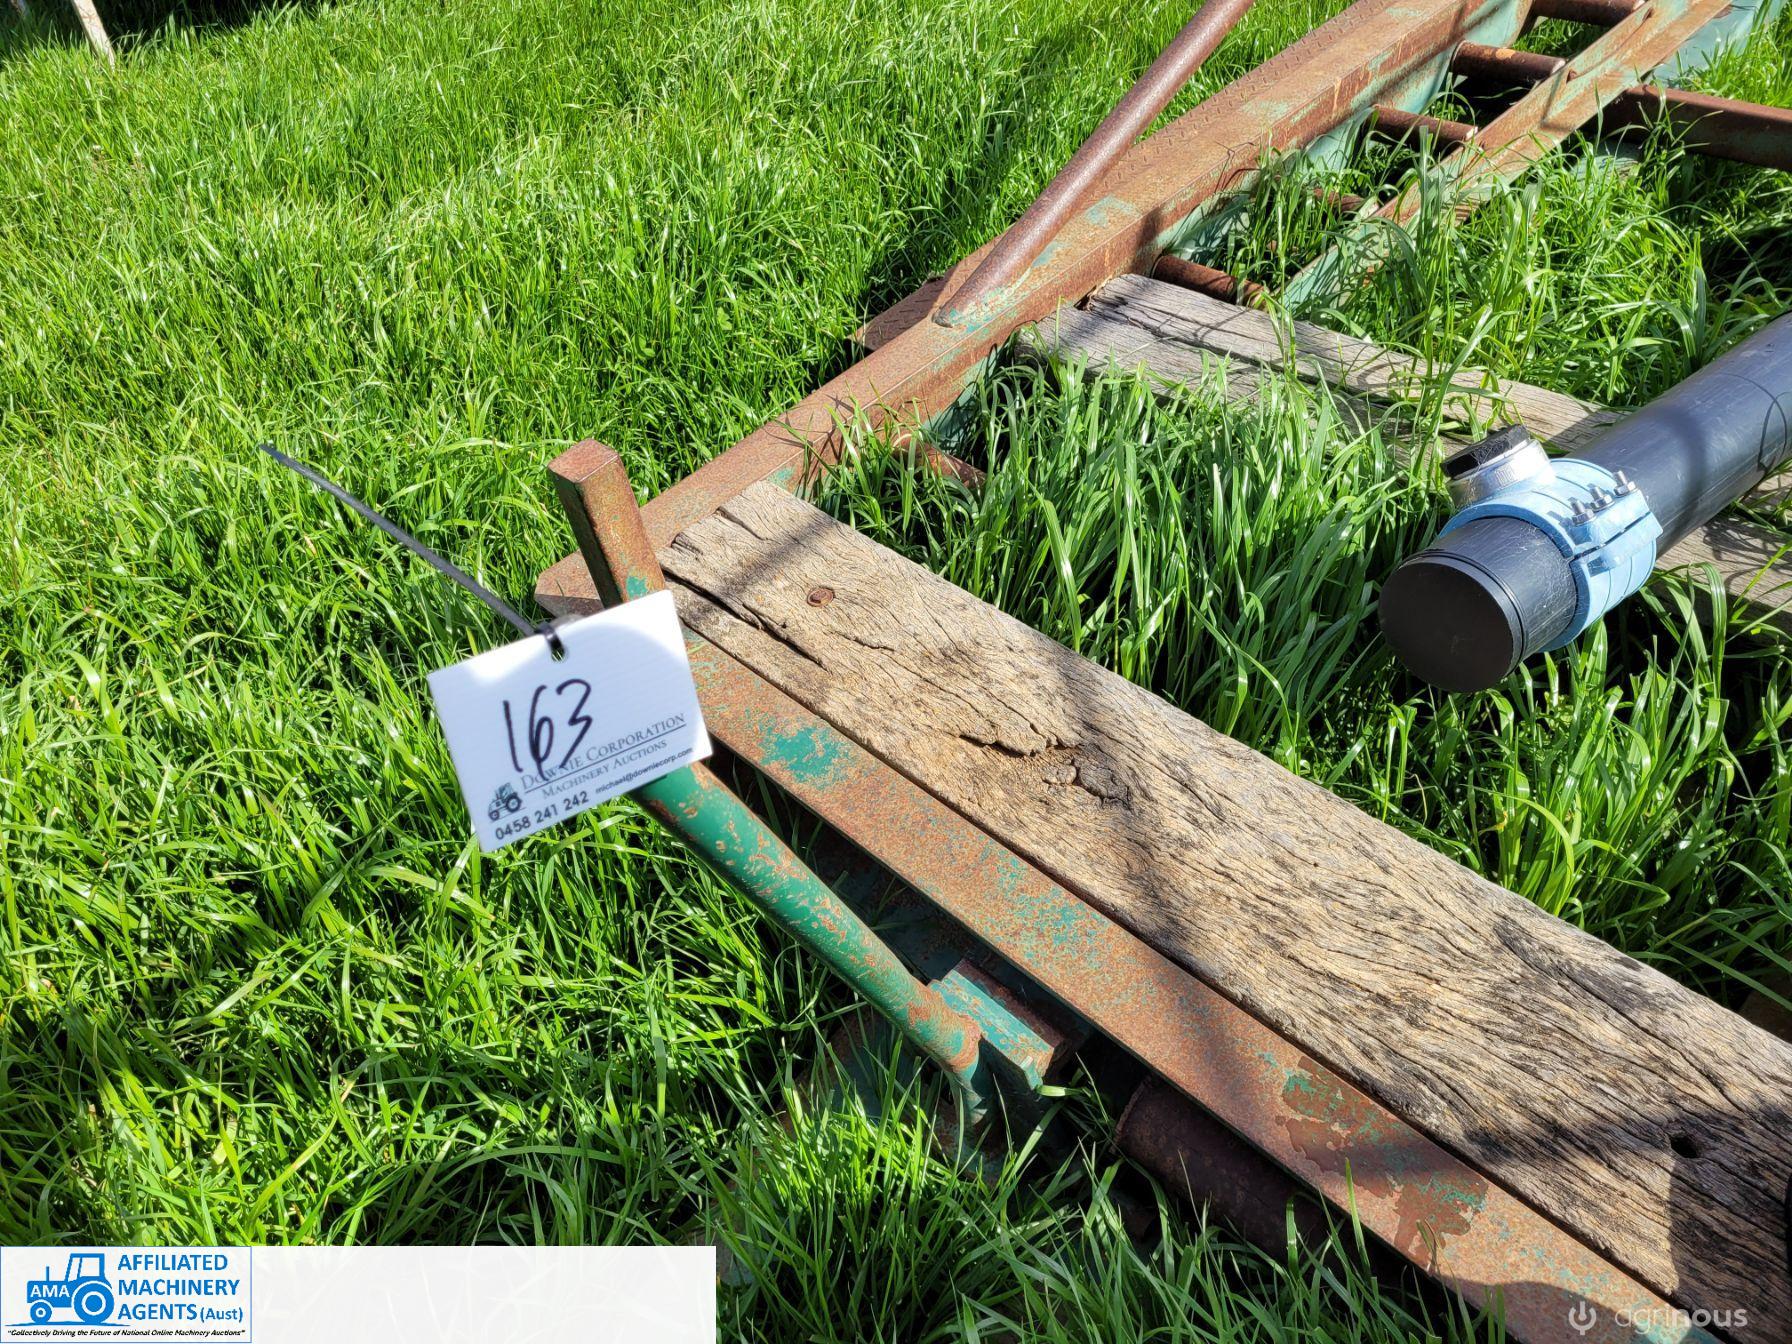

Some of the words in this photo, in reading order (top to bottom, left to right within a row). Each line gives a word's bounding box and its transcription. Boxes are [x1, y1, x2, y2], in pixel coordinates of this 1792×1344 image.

[503, 678, 593, 781] 163
[586, 713, 685, 761] CORPORATION
[541, 764, 610, 799] MACHINERY
[613, 739, 668, 770] AUCTIONS
[595, 747, 693, 794] michael@downiecorp.com
[495, 815, 531, 840] 0458
[534, 804, 558, 824] 241
[563, 790, 589, 811] 242
